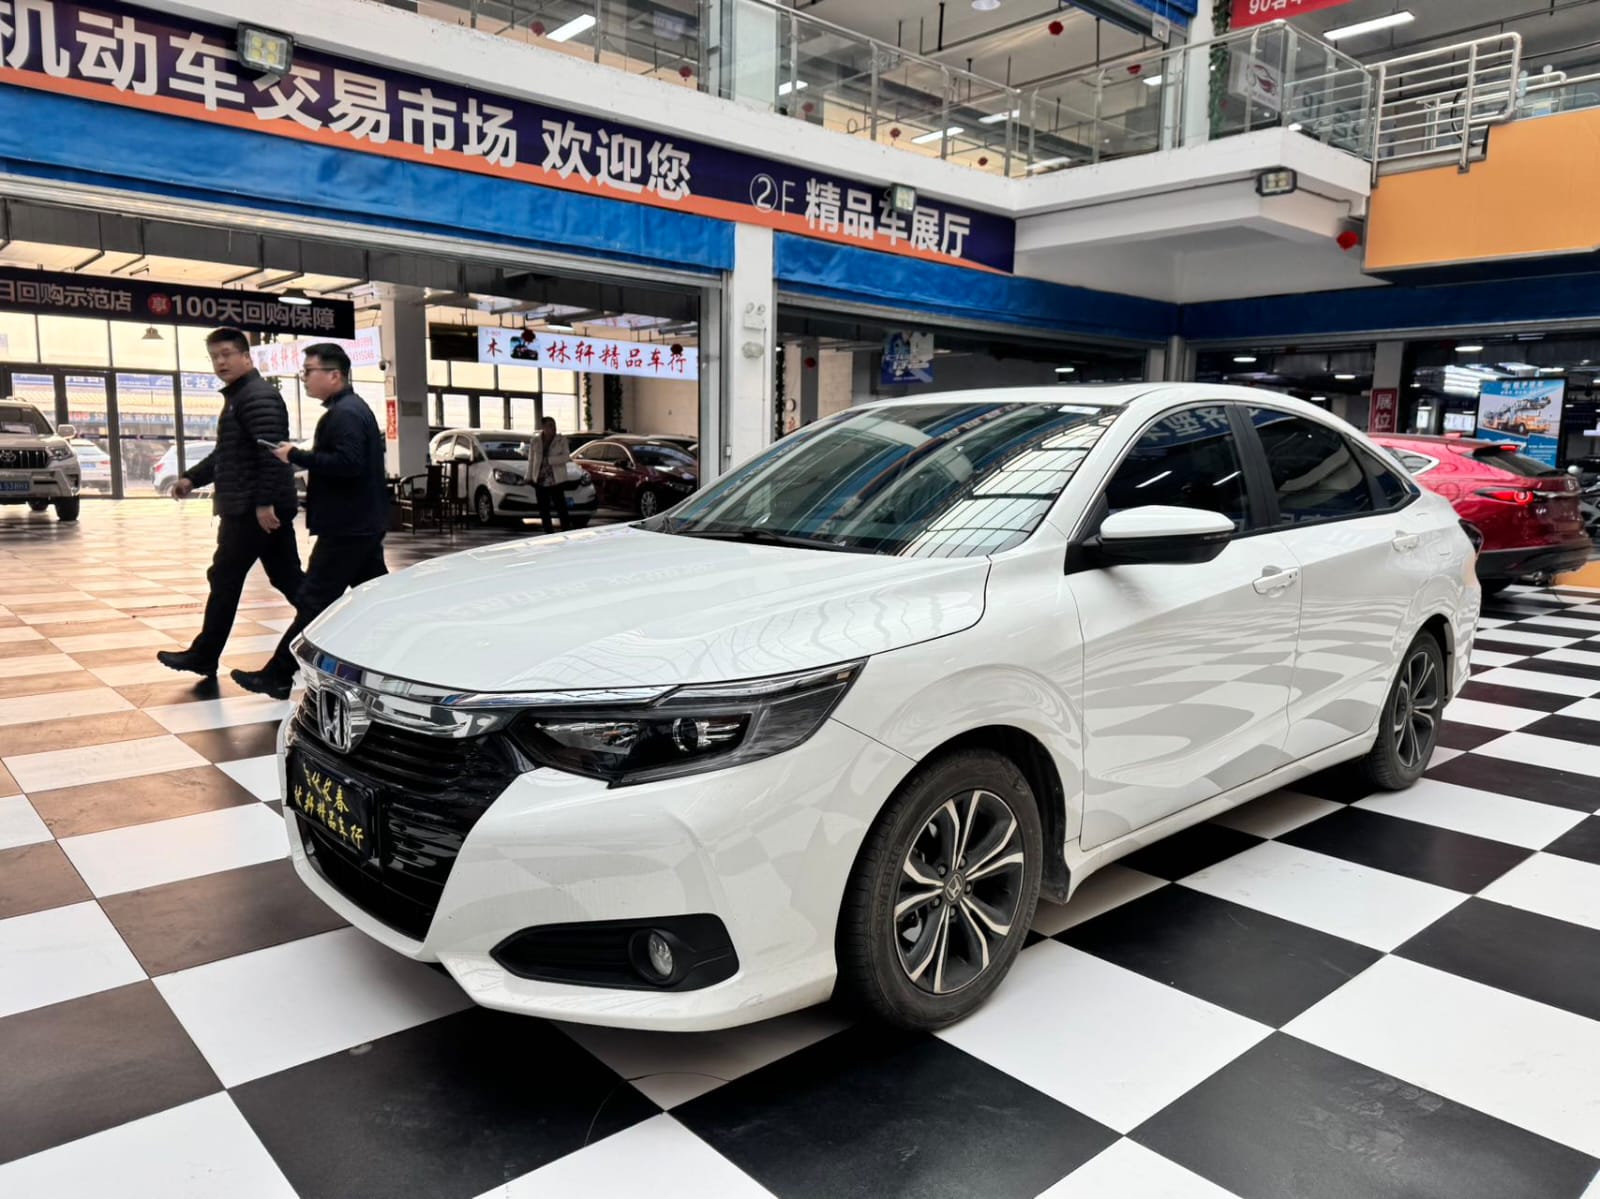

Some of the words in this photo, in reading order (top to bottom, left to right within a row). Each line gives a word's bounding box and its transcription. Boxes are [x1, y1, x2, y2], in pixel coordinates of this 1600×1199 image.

[541, 119, 692, 201] 欢迎您
[804, 176, 972, 258] 精品车展厅
[171, 294, 336, 331] 100天回购保障
[546, 340, 687, 373] 林轩精品车行
[1374, 393, 1392, 430] 展位
